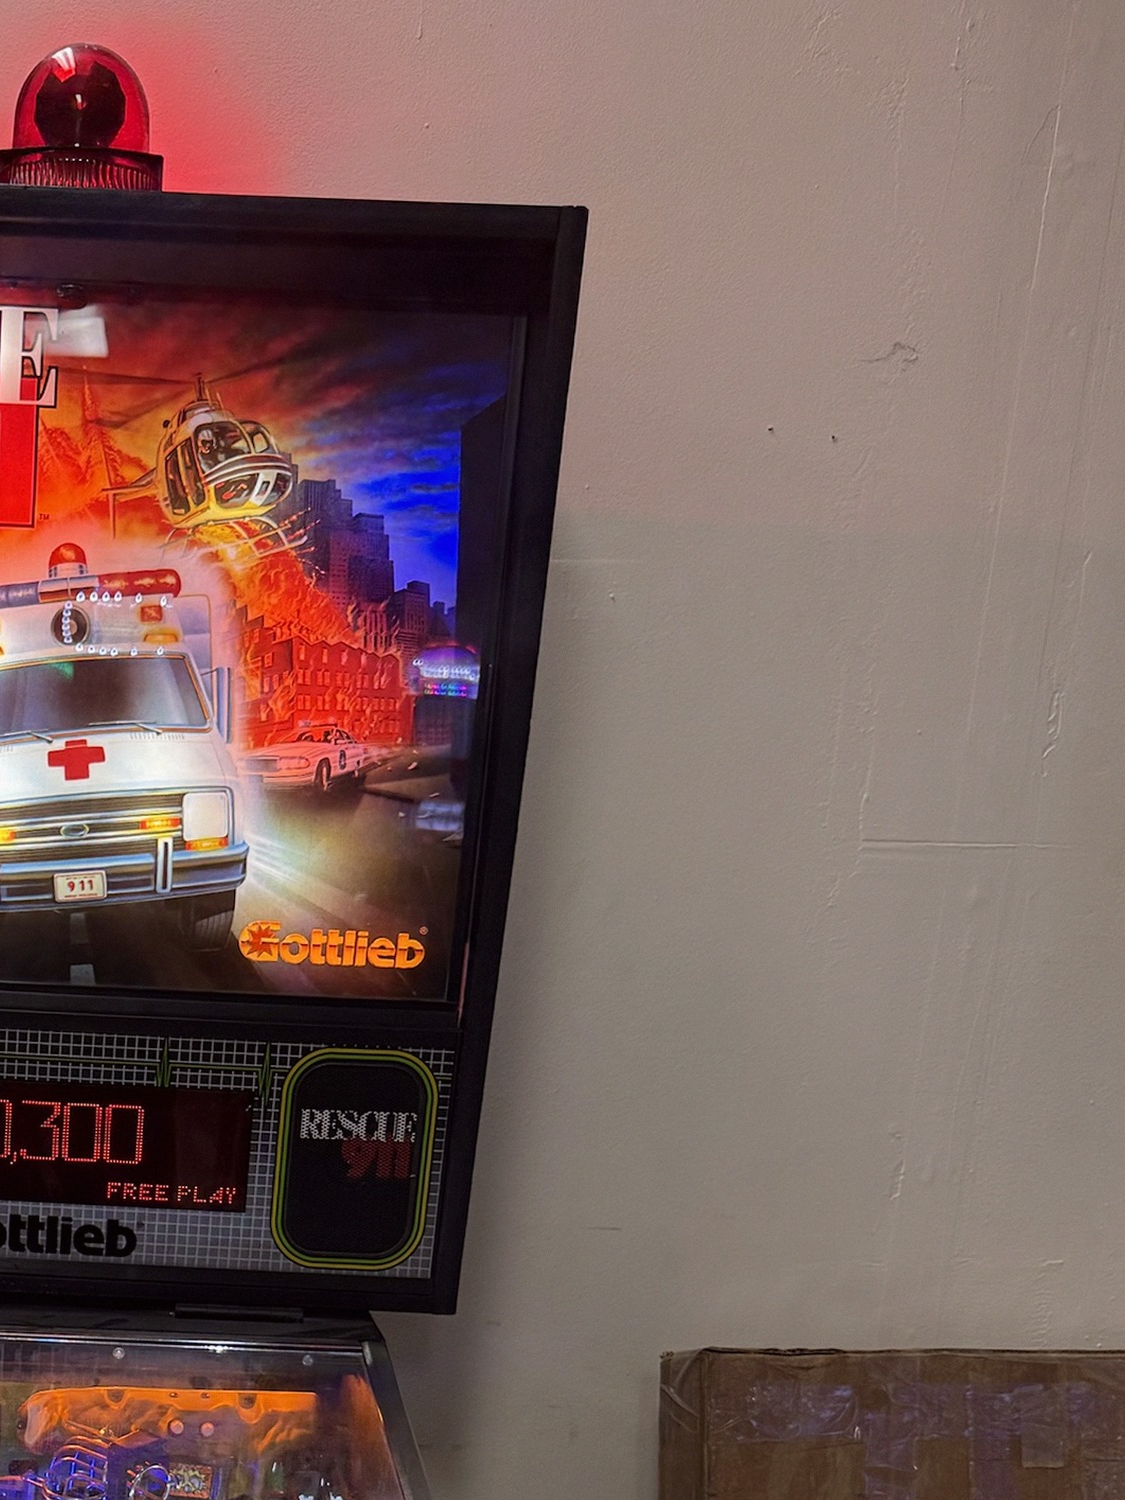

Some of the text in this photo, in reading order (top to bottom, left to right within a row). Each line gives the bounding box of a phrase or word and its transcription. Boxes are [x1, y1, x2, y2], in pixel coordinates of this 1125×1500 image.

[67, 880, 93, 892] 911
[238, 919, 425, 969] Gottlieb
[300, 1109, 418, 1143] RESCUE
[342, 1138, 412, 1179] 911
[106, 1181, 237, 1205] FREE PLAY
